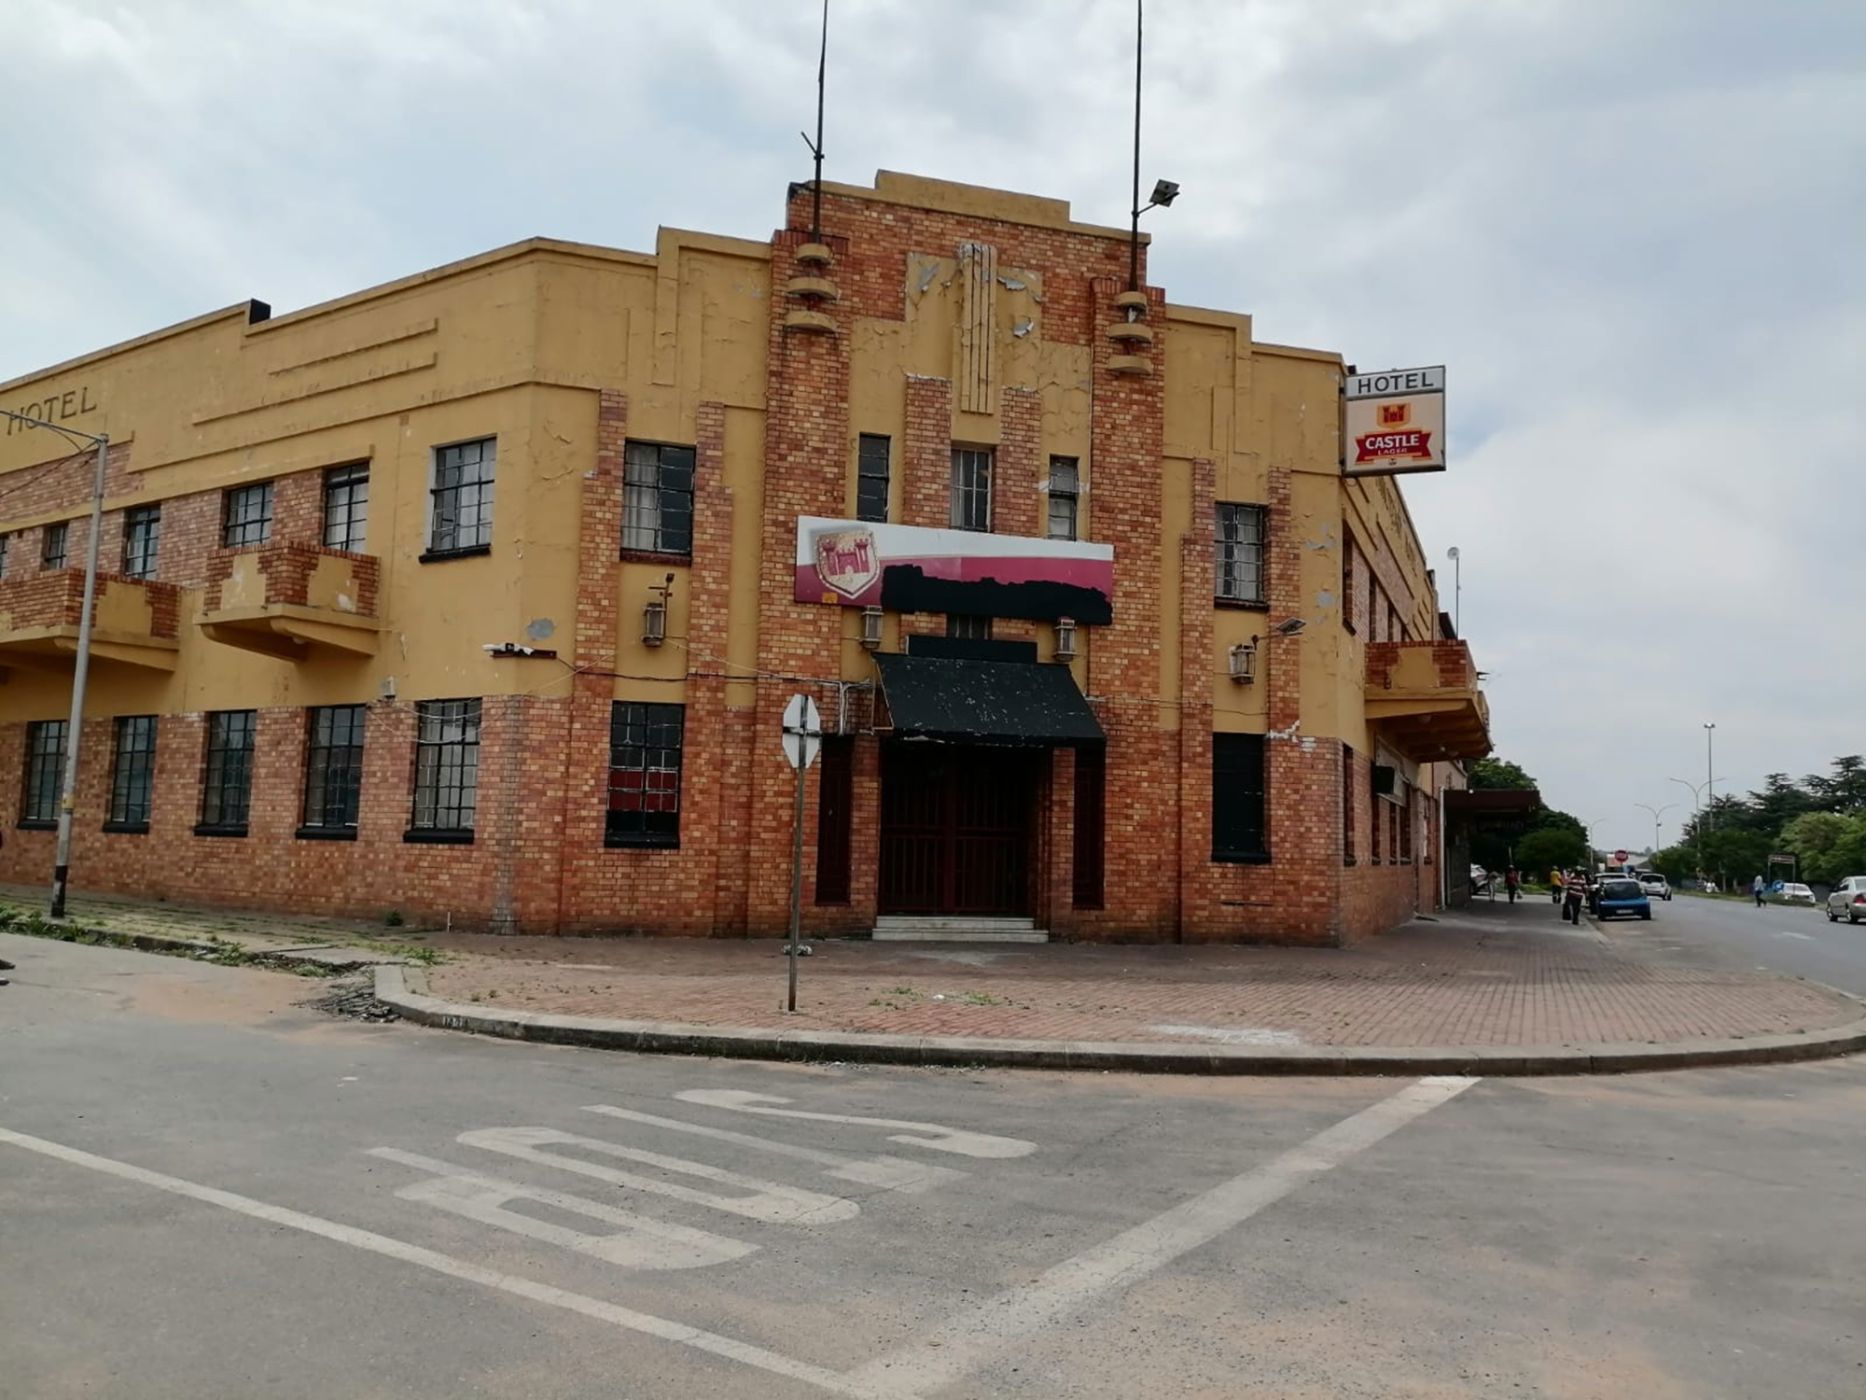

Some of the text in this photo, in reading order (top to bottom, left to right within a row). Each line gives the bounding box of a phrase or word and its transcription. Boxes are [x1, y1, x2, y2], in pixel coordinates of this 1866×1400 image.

[1358, 372, 1434, 394] HOTEL
[7, 386, 97, 436] HOTEL
[1365, 434, 1420, 449] CASTLE
[365, 1089, 1038, 1270] STOP
